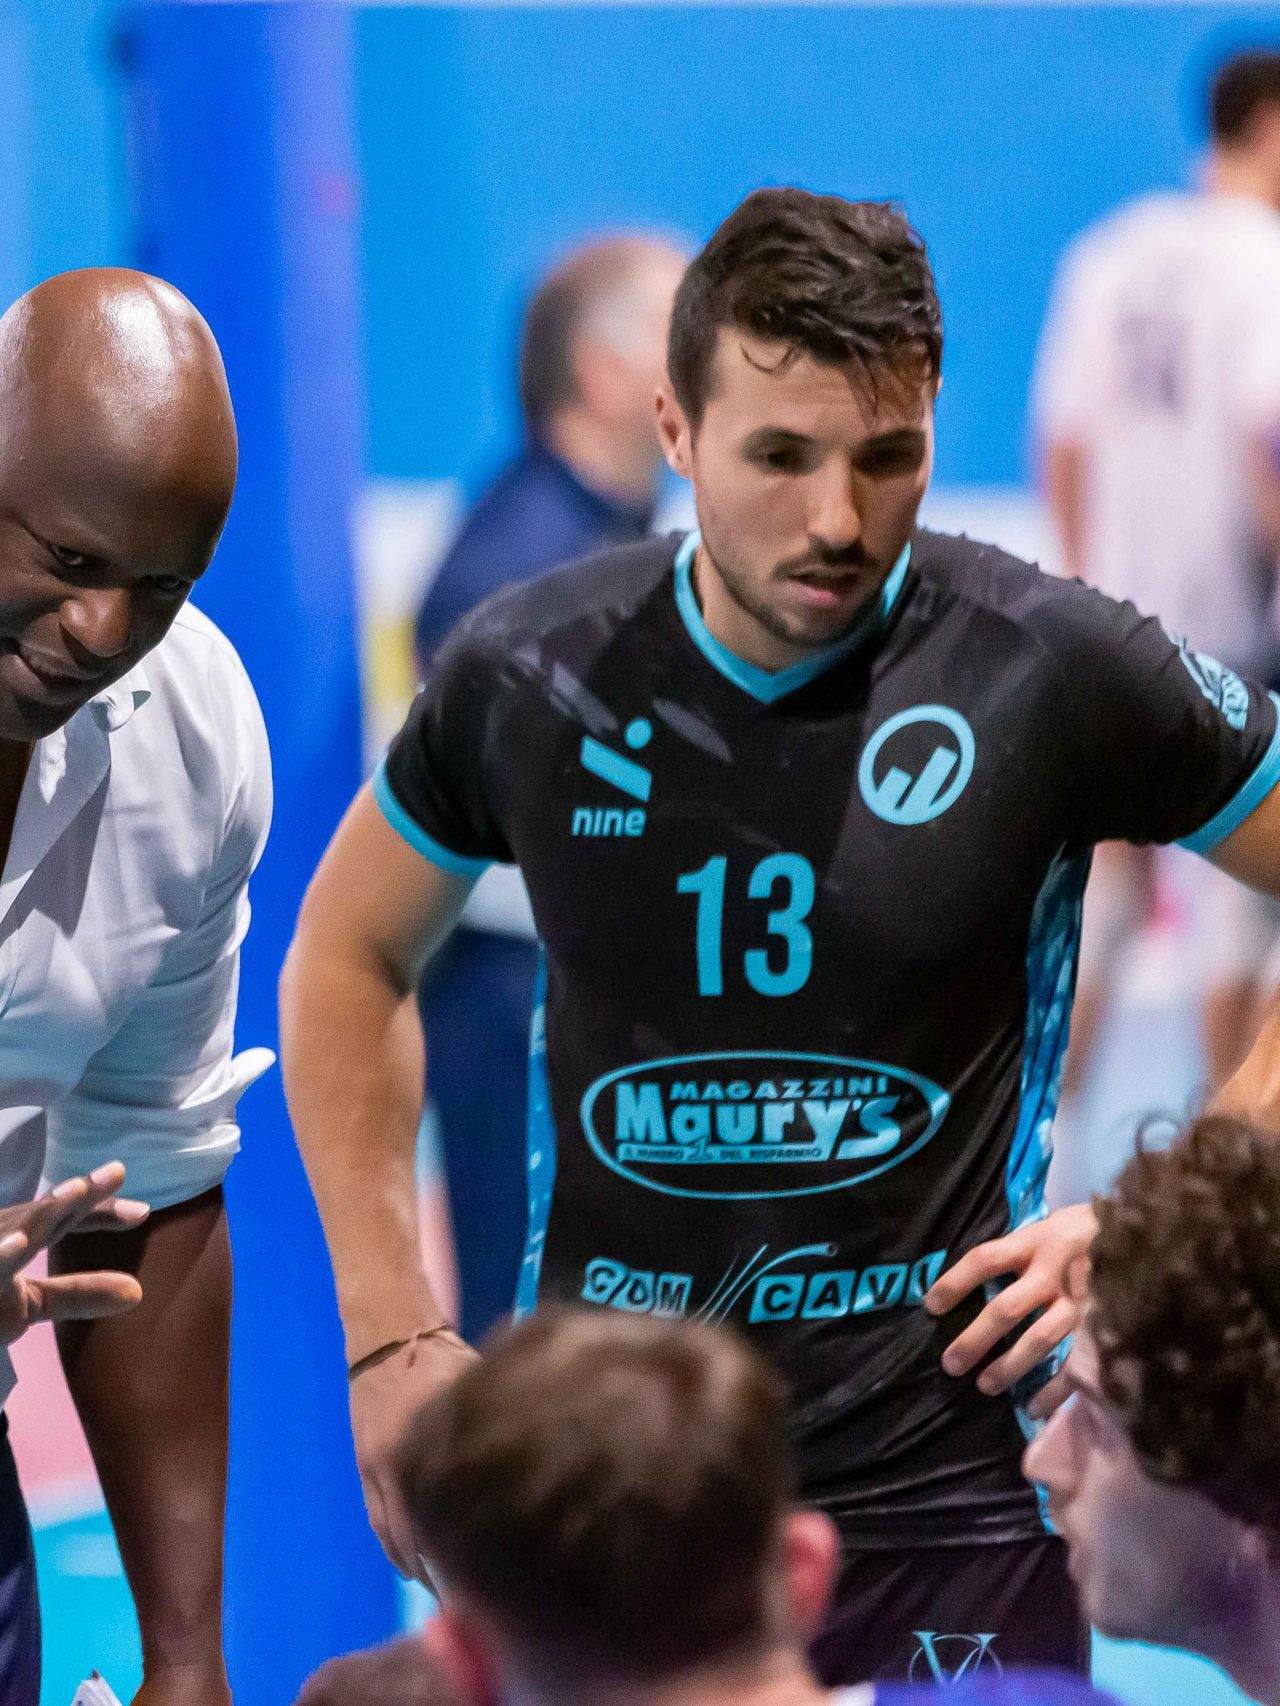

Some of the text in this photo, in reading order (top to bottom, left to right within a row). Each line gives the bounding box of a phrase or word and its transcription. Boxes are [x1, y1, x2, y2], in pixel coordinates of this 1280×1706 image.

[572, 807, 647, 837] nine
[676, 851, 816, 998] 13
[670, 1075, 889, 1101] MAGAZZINI
[615, 1081, 902, 1162] Maury's
